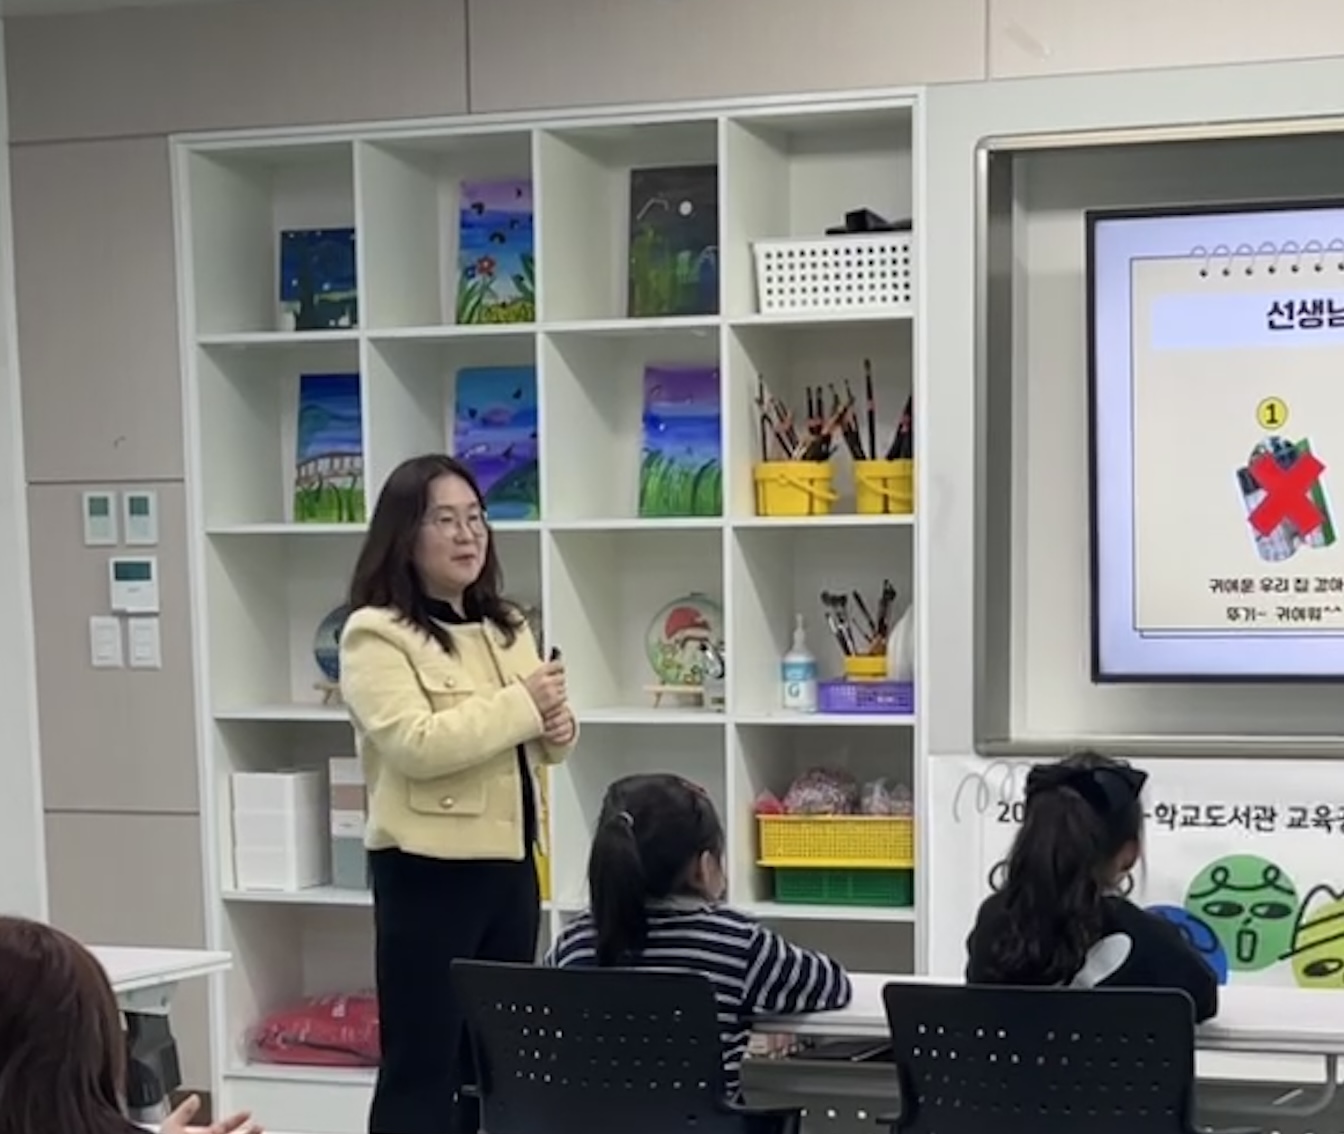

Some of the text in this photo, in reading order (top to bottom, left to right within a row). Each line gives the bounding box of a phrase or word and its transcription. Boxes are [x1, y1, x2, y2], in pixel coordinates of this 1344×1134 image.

[1260, 577, 1289, 594] 우리
[997, 803, 1026, 823] 20
[1144, 804, 1278, 833] -학교도서관
